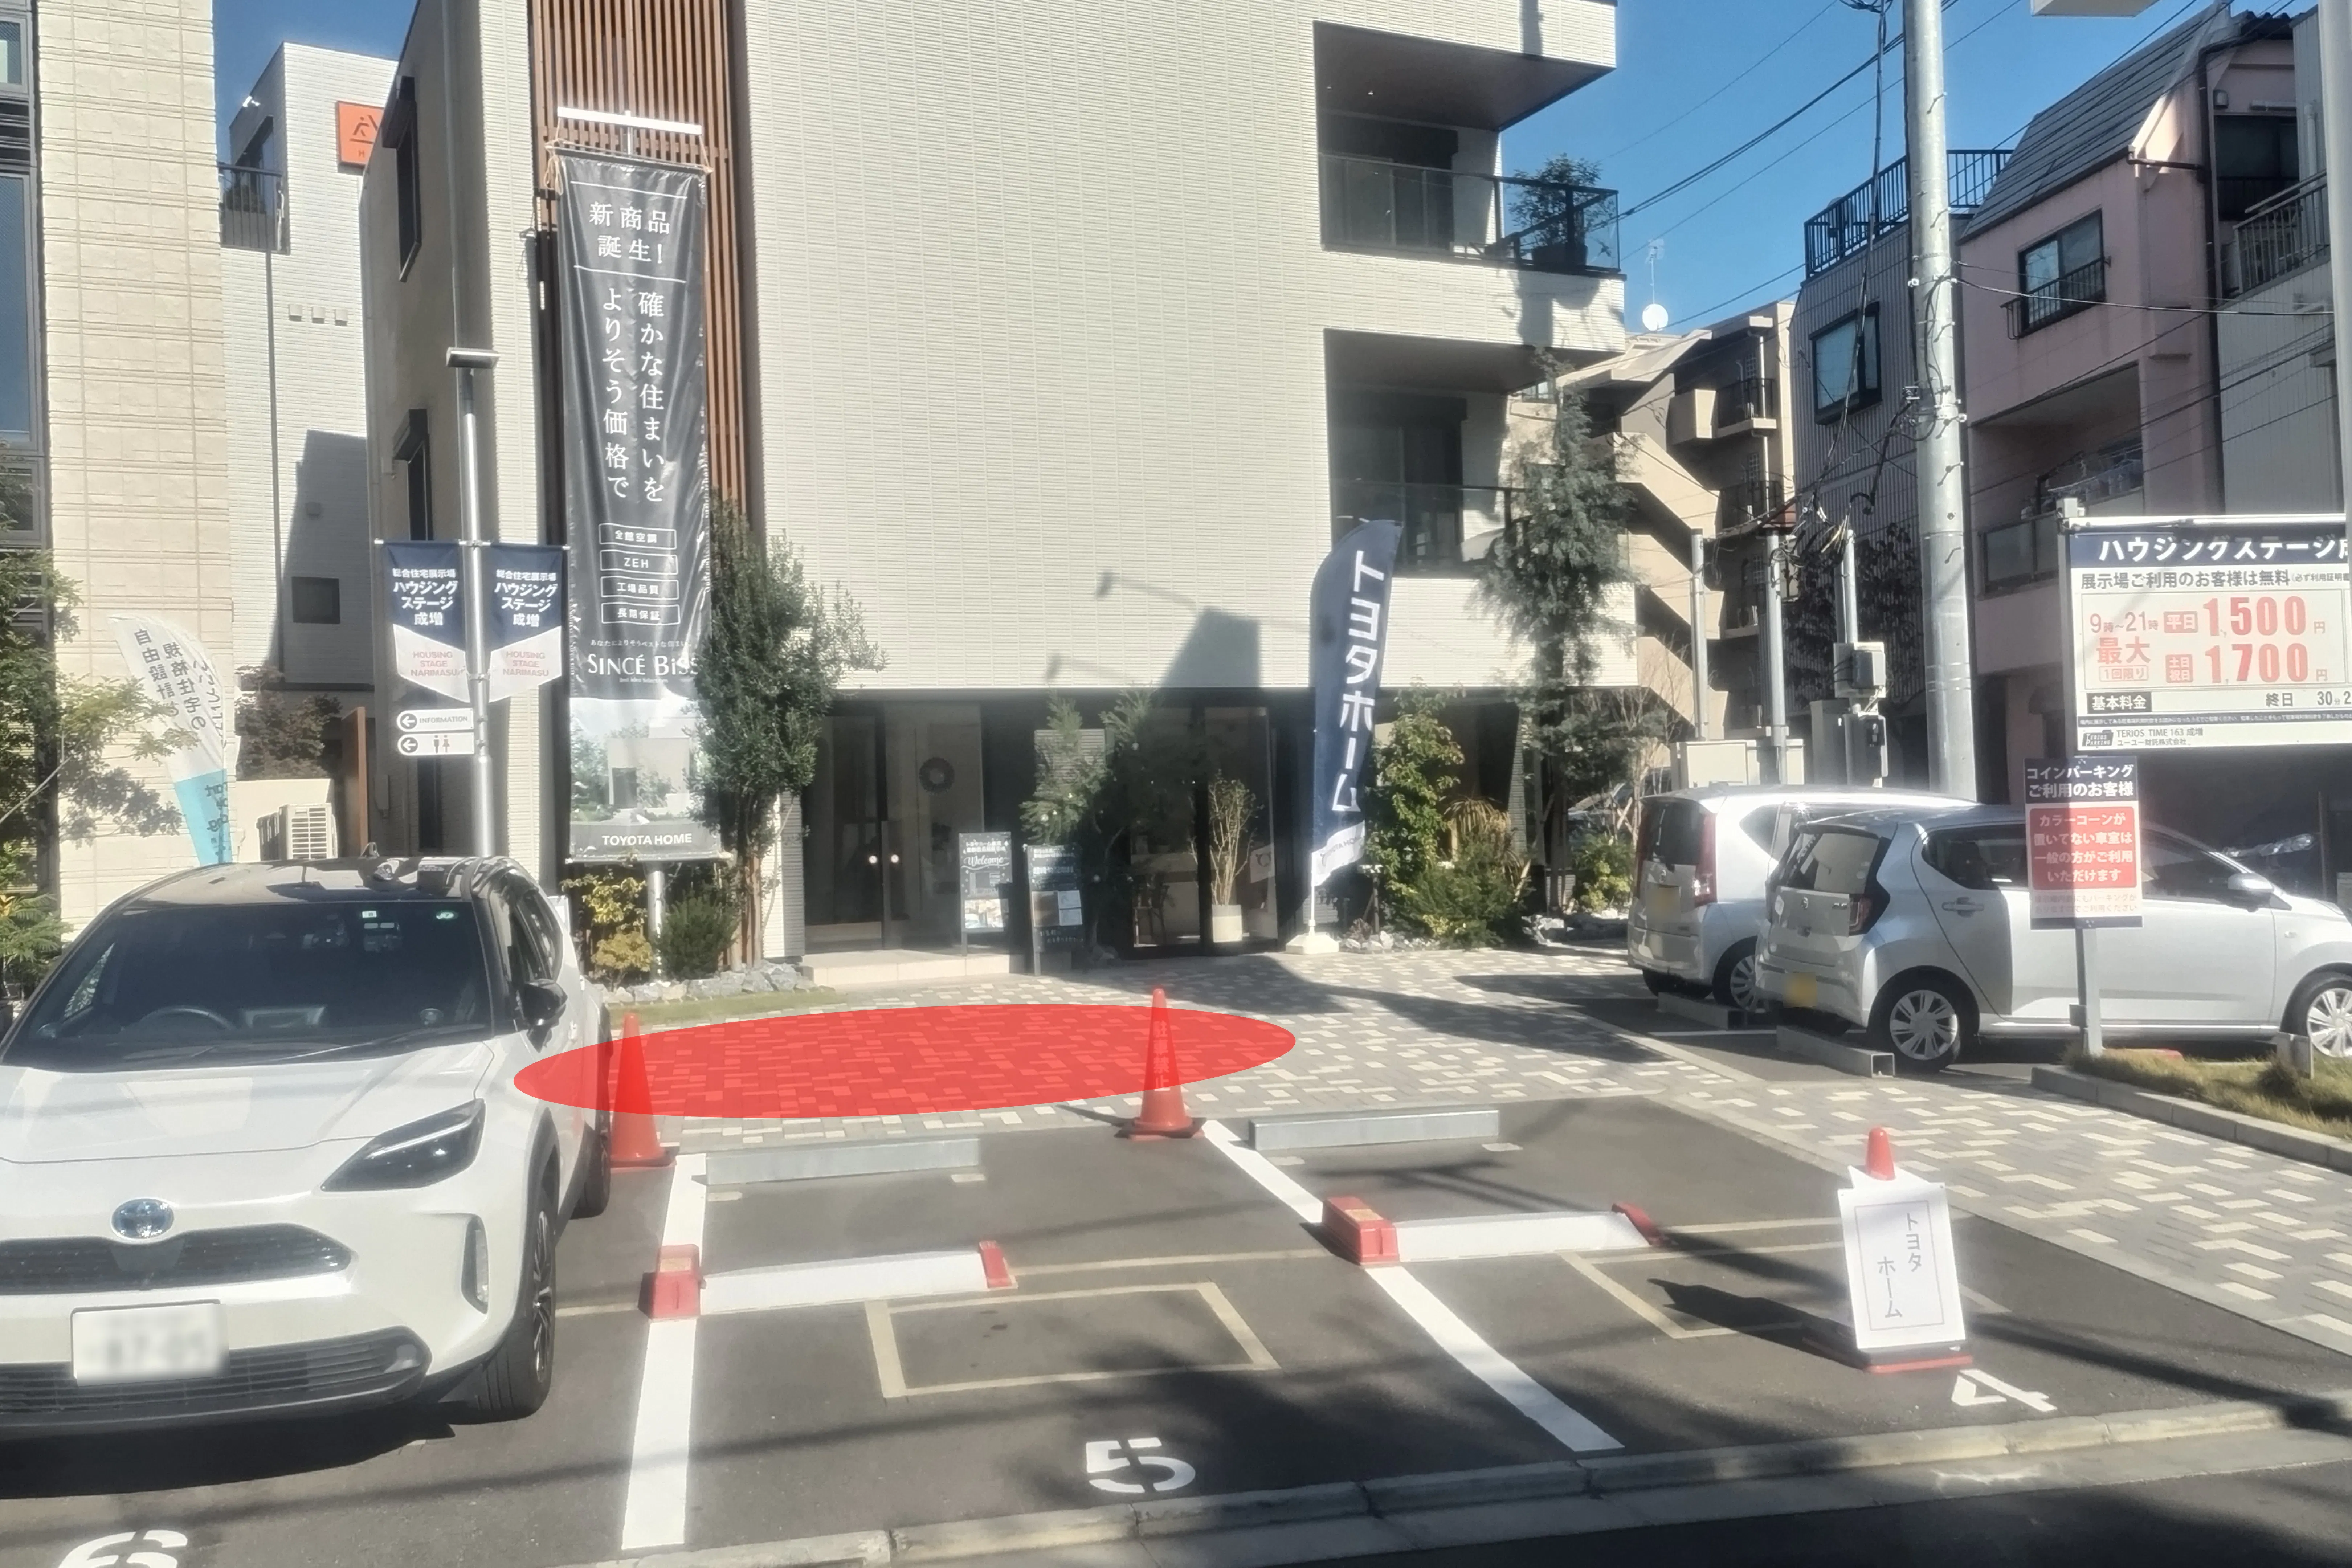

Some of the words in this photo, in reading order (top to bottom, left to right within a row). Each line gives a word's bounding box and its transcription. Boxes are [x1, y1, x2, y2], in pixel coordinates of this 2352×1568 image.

[590, 201, 670, 234] 新商品
[603, 287, 629, 499] よりそう価格で
[638, 291, 664, 502] 確かな住まいを
[615, 530, 657, 543] 全館空調
[624, 557, 649, 568] ZEH
[392, 568, 456, 579] 総合住宅展示場
[496, 569, 556, 581] 総合住宅展示場
[2081, 569, 2290, 589] 展示場ご利用のお客様は無料
[393, 581, 458, 595] ハウジング
[494, 582, 558, 597] ハウジング
[617, 582, 658, 595] 工場品質
[401, 596, 453, 610] ステージ
[501, 597, 551, 612] ステージ
[414, 612, 443, 626] 成増
[513, 613, 539, 628] 成増
[618, 608, 660, 620] 長期保証
[2167, 614, 2196, 630] 平日
[506, 651, 545, 659] HOUSING
[2096, 636, 2151, 664] 最大
[588, 654, 645, 675] SINCÉ
[2169, 657, 2190, 668] 土日
[503, 668, 549, 677] NARIMASU
[2104, 668, 2144, 680] 1回限り
[2169, 670, 2190, 681] 祝日
[1332, 550, 1384, 812] トヨタホーム
[2092, 695, 2147, 710] 基本料金
[2266, 693, 2293, 707] 終日
[2027, 764, 2134, 779] コインパーキング
[2029, 781, 2133, 798] ご利用のお客様
[2039, 813, 2125, 826] カラーコーンが
[602, 836, 652, 845] TOYOTA
[654, 834, 692, 844] HOME
[2034, 832, 2132, 846] 置いてない車室は
[964, 855, 1004, 867] Welcome
[2034, 850, 2133, 864] 一般の方がご利用
[2048, 869, 2121, 882] いただけます
[1906, 1213, 1922, 1272] トヨタ
[1877, 1256, 1903, 1319] ホーム
[1086, 1437, 1196, 1493] 5
